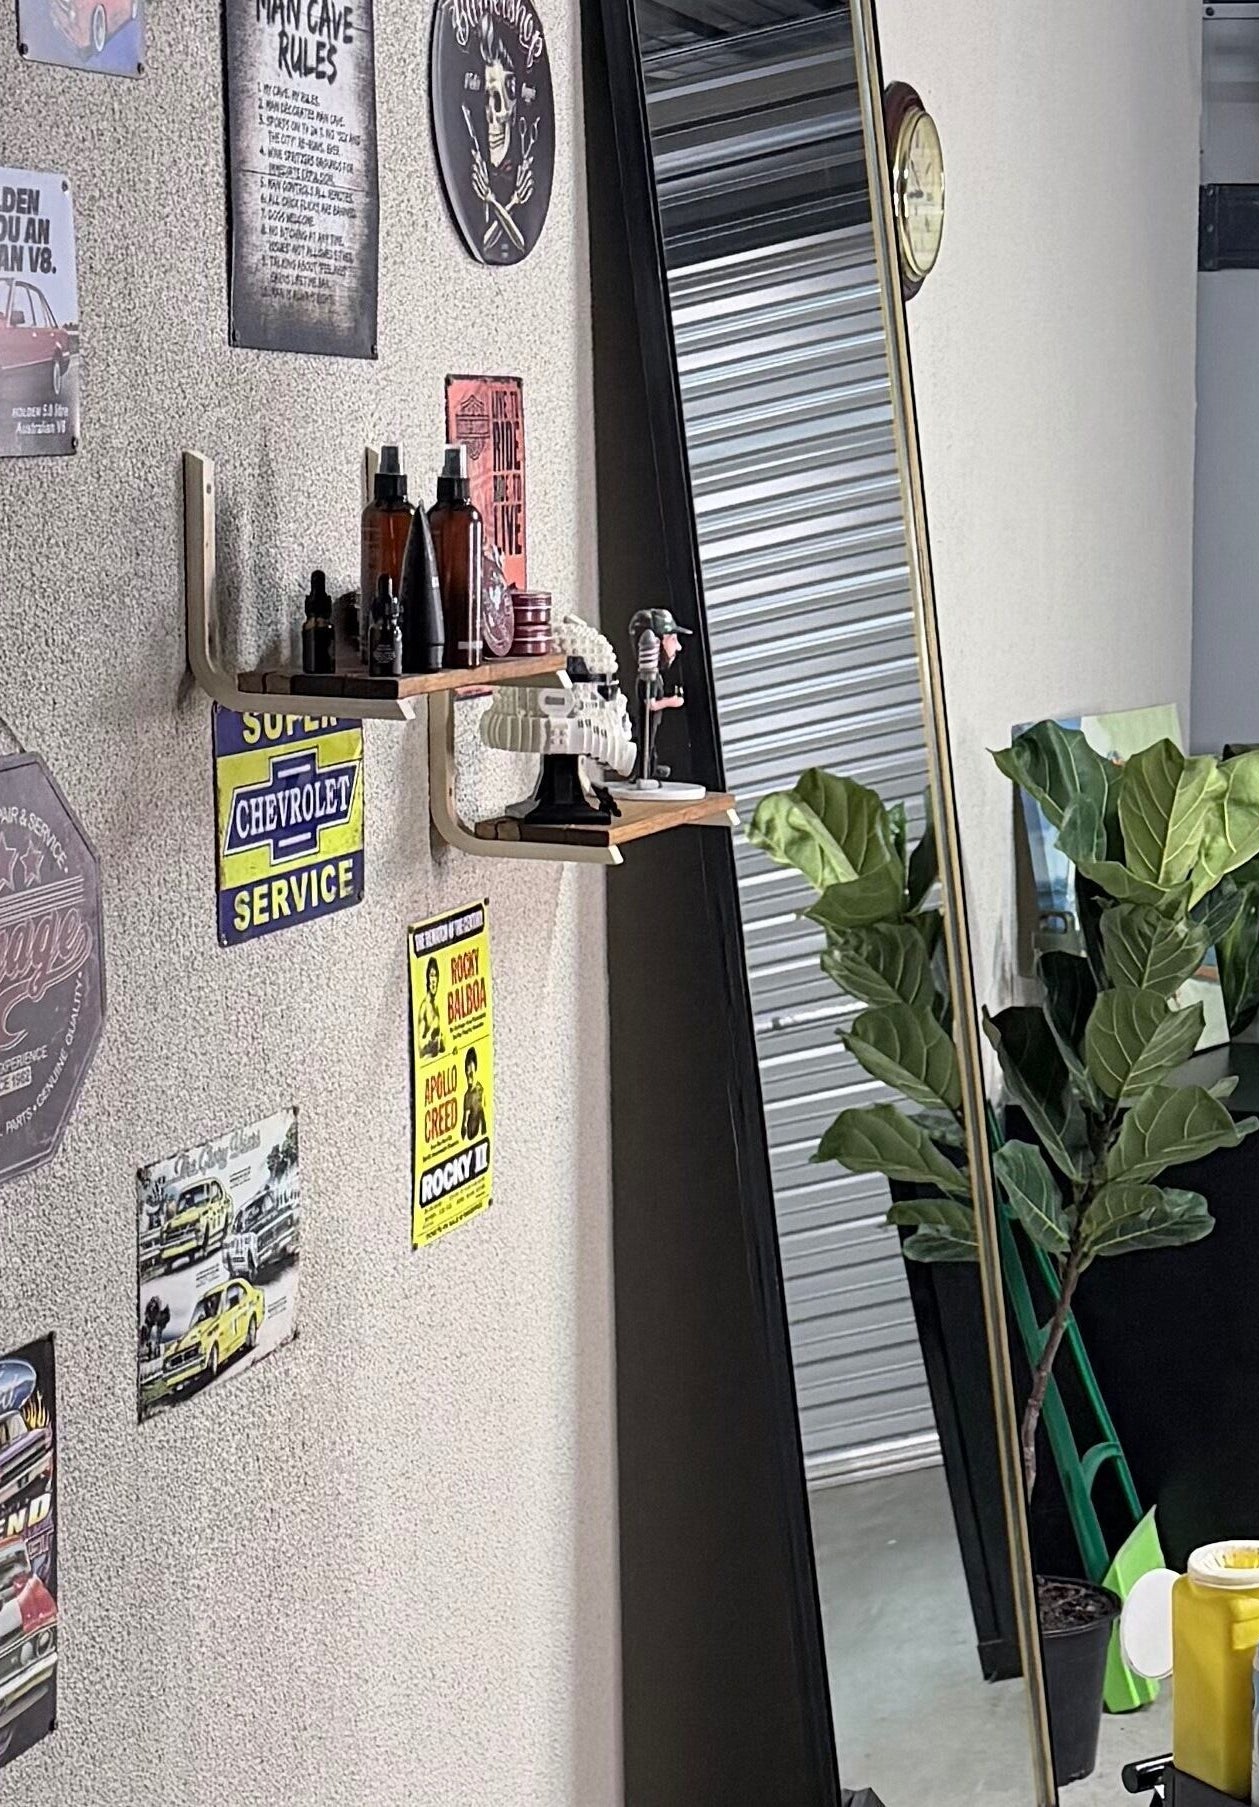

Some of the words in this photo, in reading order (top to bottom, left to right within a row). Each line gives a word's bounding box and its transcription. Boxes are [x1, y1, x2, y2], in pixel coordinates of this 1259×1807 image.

[257, 0, 301, 30] MAN
[307, 0, 353, 44] CAVE
[278, 30, 338, 85] RULES
[0, 186, 40, 215] DEN
[24, 217, 50, 245] AN
[28, 244, 57, 275] V8.
[493, 421, 521, 472] RIDE
[235, 775, 350, 839] CHEVROLET
[233, 859, 354, 932] SERVICE
[451, 947, 480, 985] ROCKY
[65, 979, 84, 1046] QUALITY
[447, 977, 487, 1025] BALBOA
[37, 1048, 68, 1107] GENUINE
[424, 1064, 458, 1107] APOLLO
[6, 1107, 32, 1134] PARTS
[424, 1097, 458, 1143] CREED
[421, 1150, 473, 1204] ROCKY
[474, 1142, 488, 1174] II
